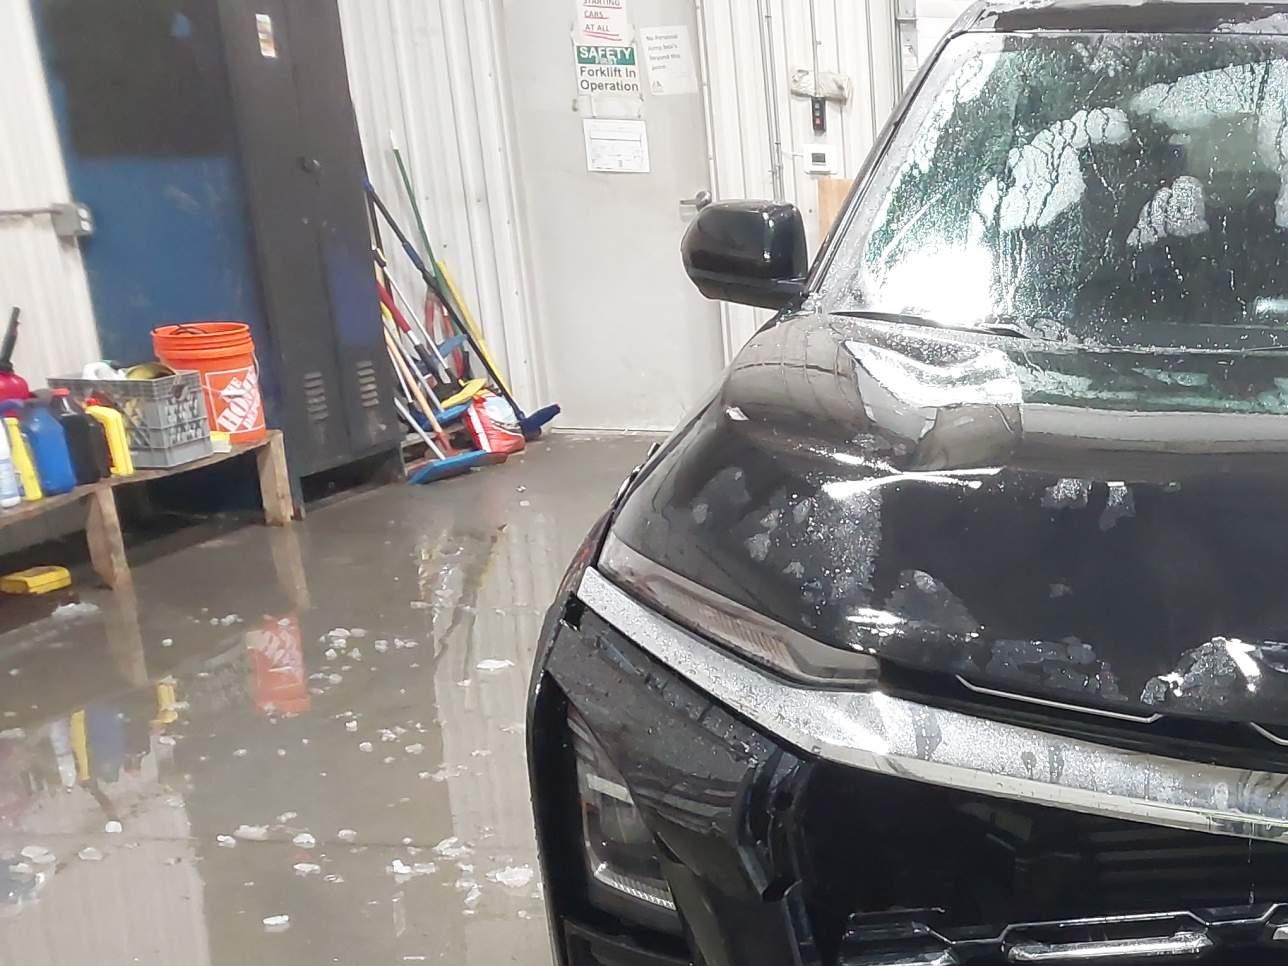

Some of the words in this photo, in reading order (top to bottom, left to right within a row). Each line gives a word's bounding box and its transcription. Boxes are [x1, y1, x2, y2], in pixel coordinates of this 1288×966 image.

[579, 46, 631, 60] SAFETY
[580, 66, 622, 78] Forklift
[625, 67, 636, 78] In
[580, 79, 639, 92] Operation
